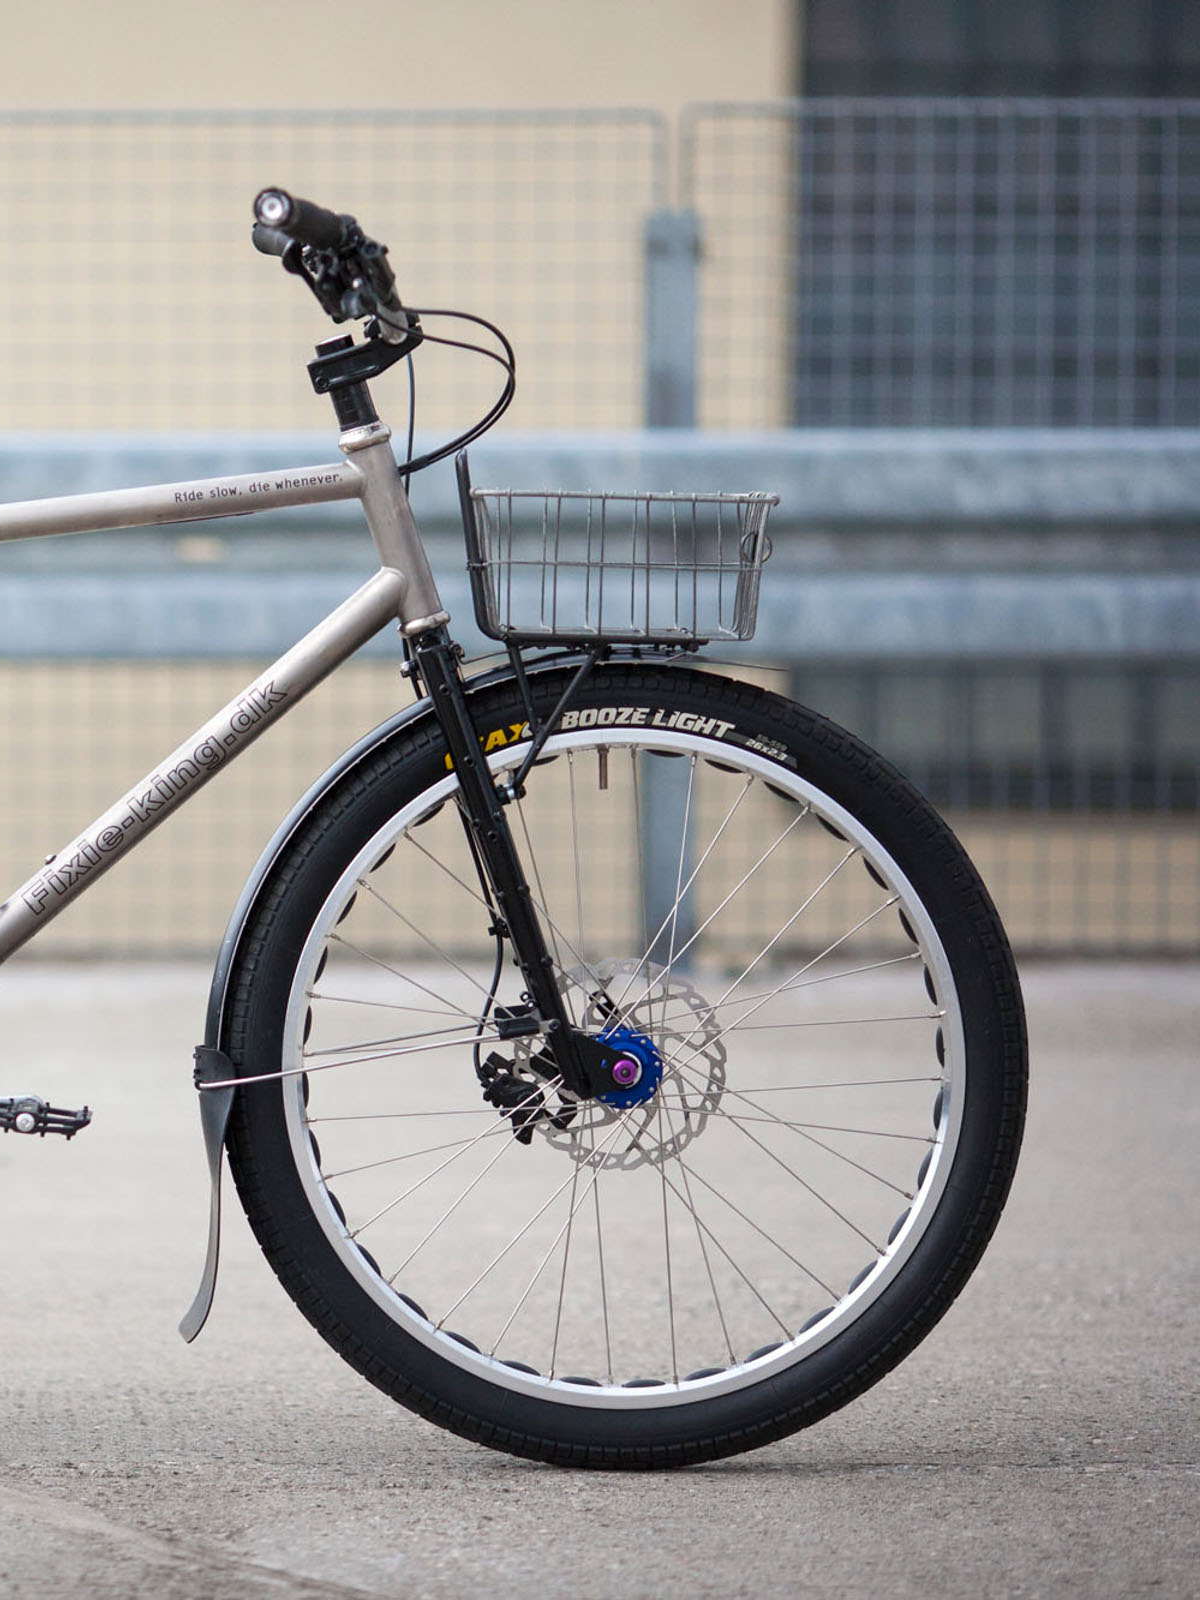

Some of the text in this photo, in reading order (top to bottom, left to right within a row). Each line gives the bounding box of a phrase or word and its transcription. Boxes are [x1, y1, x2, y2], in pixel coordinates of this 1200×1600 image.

[174, 472, 344, 504] Ride slow, die whenever.
[561, 707, 650, 729] BOOZE
[21, 680, 287, 916] Fixie-king.dk
